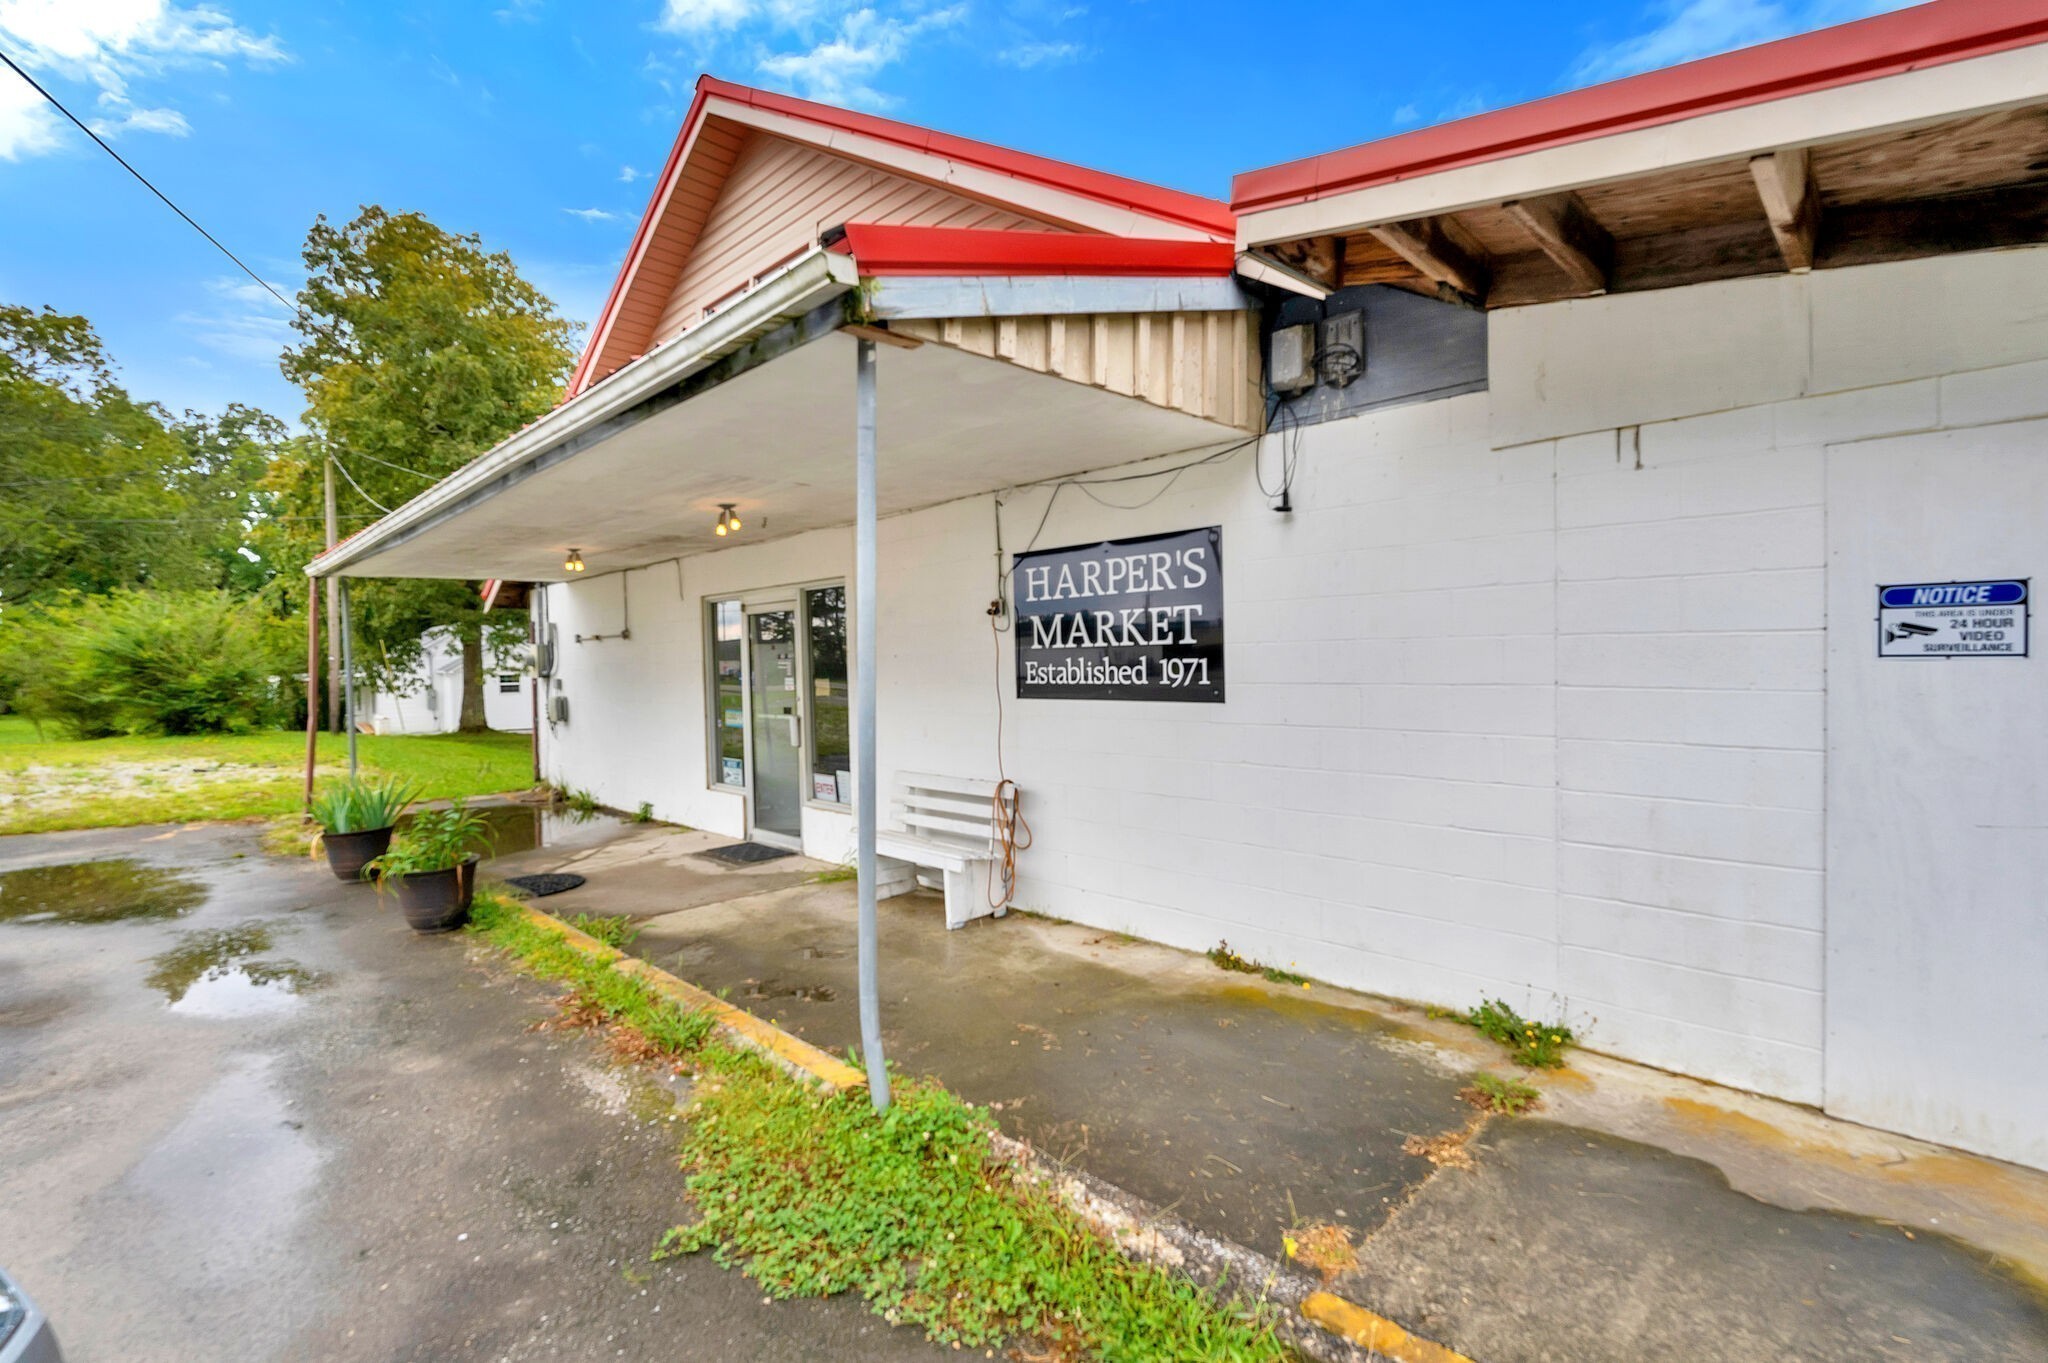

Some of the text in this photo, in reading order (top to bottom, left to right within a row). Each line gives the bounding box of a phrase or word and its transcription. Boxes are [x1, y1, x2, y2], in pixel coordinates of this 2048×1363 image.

[1025, 547, 1207, 602] HARPER'S
[1912, 586, 1993, 604] NOTICE
[1937, 610, 1963, 618] AREA
[1967, 609, 1975, 617] IS
[1978, 608, 2015, 617] UNDER
[1030, 604, 1203, 649] MARKET
[1949, 618, 2014, 629] 24 HOUR
[1959, 631, 2005, 641] VIDEO
[1923, 642, 2013, 652] SURVEILLANCE
[1025, 655, 1211, 688] Established 1971
